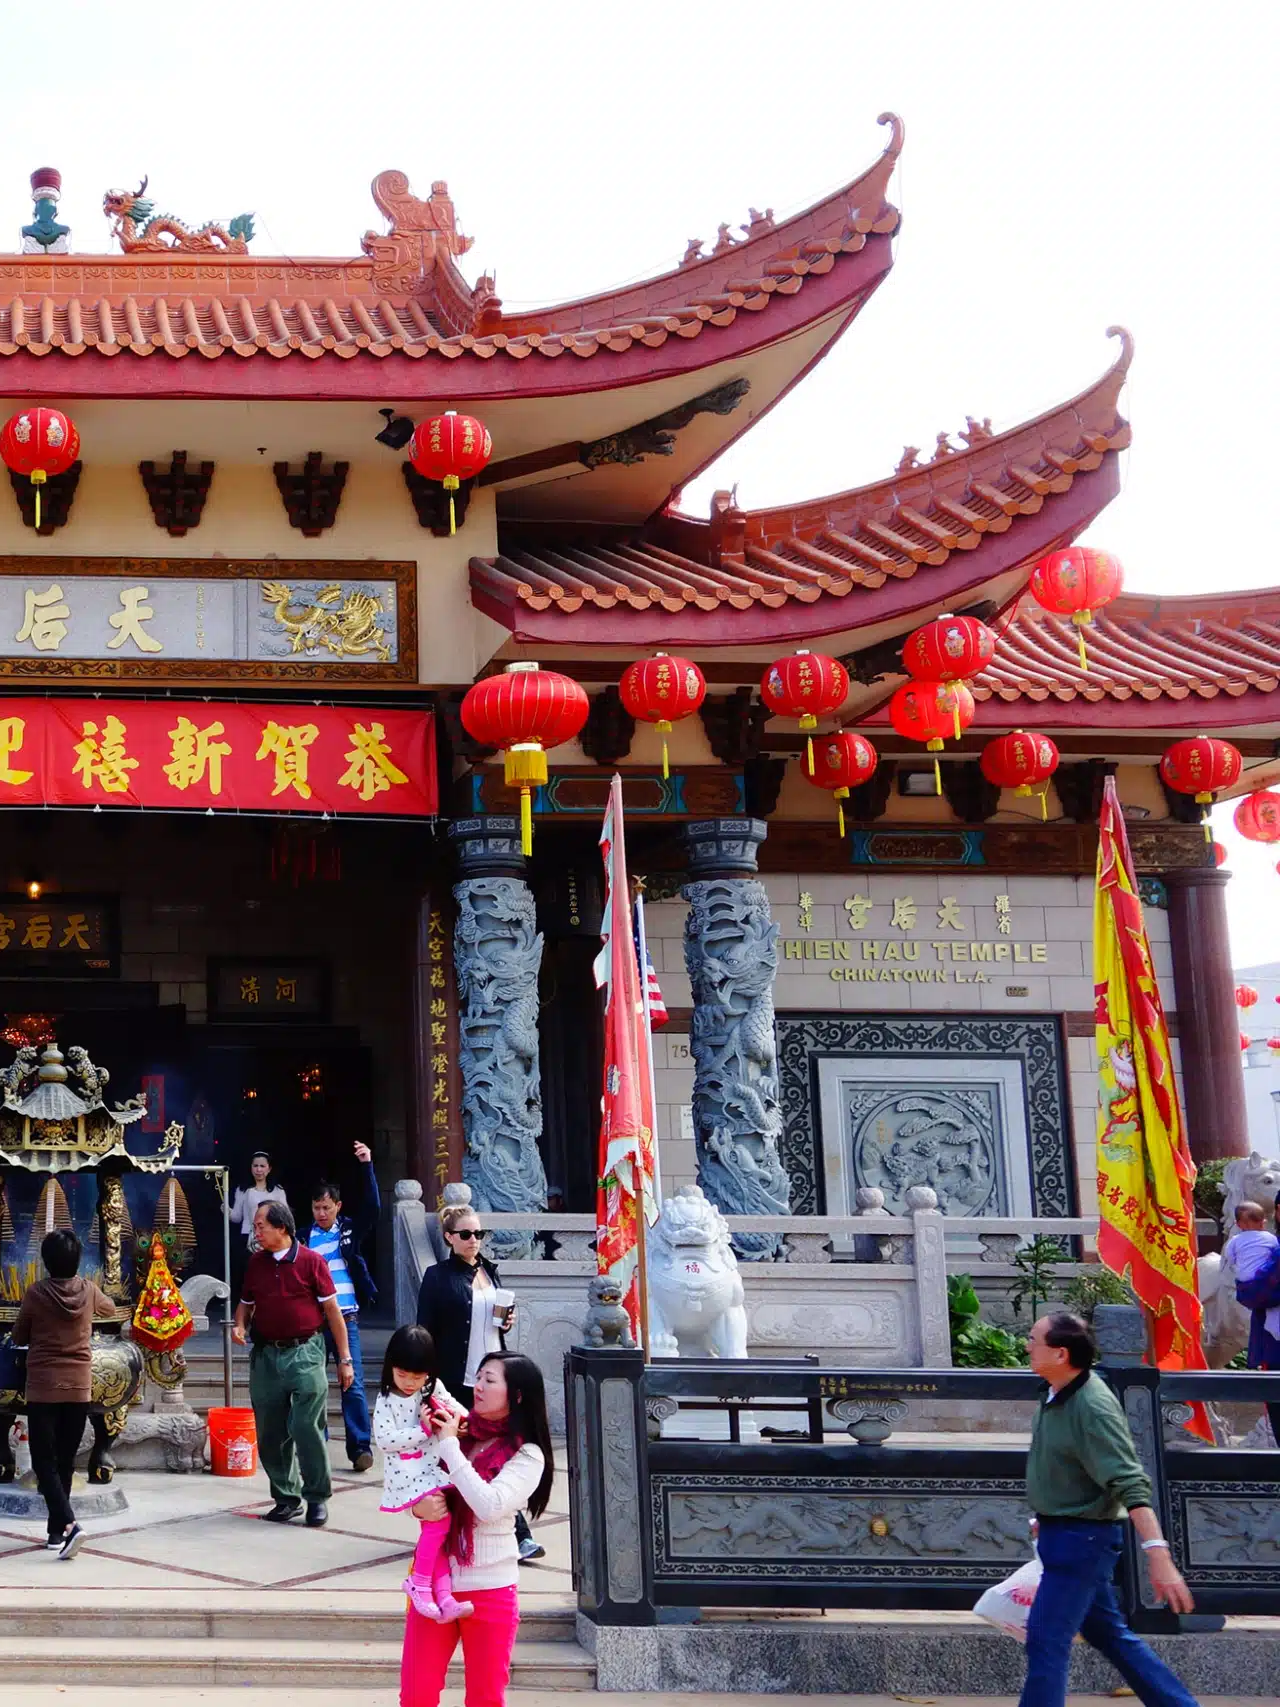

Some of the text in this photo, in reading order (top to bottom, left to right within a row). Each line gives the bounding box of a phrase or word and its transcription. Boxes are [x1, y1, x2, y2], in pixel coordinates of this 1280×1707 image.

[798, 892, 814, 932] 華埠
[844, 894, 965, 931] 天后宮
[995, 895, 1012, 934] 羅省
[784, 939, 1049, 963] HIEN HAU TEMPLE
[240, 975, 297, 1004] 河清
[830, 967, 993, 984] CHINATOWN L.A.
[685, 1261, 700, 1274] 福
